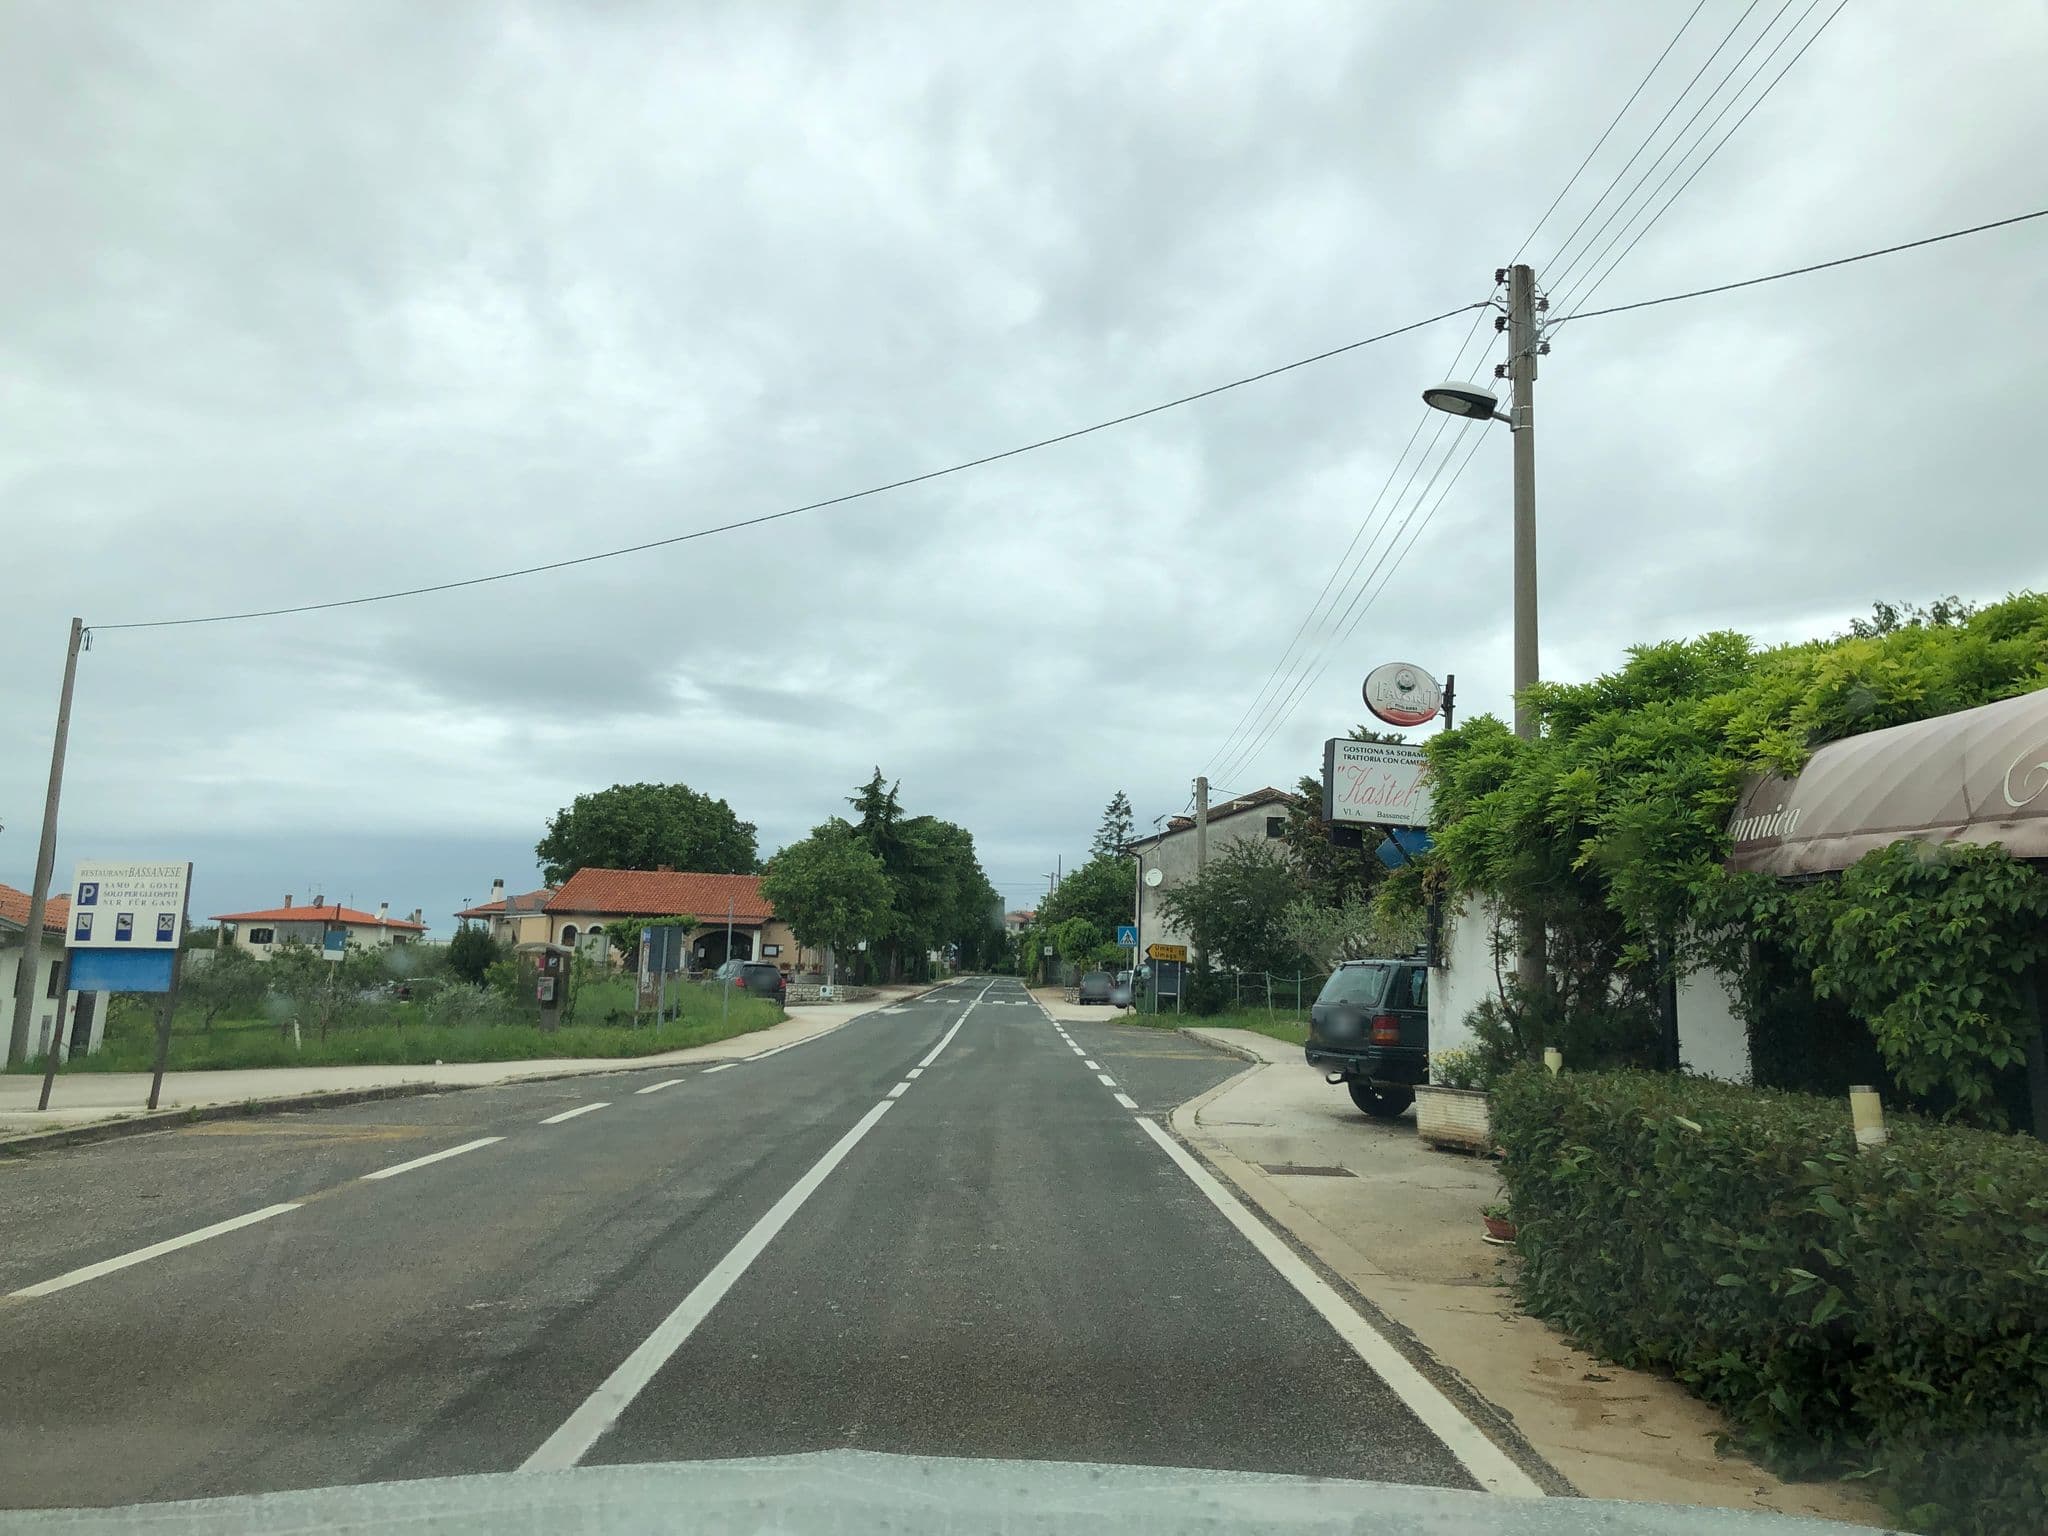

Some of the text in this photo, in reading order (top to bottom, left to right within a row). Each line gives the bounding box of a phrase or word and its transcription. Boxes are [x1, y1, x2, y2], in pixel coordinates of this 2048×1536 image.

[1343, 746, 1384, 755] GOSTIONA
[1343, 754, 1380, 762] TRATTORIA
[1376, 811, 1410, 820] Bassanese
[81, 885, 96, 904] P
